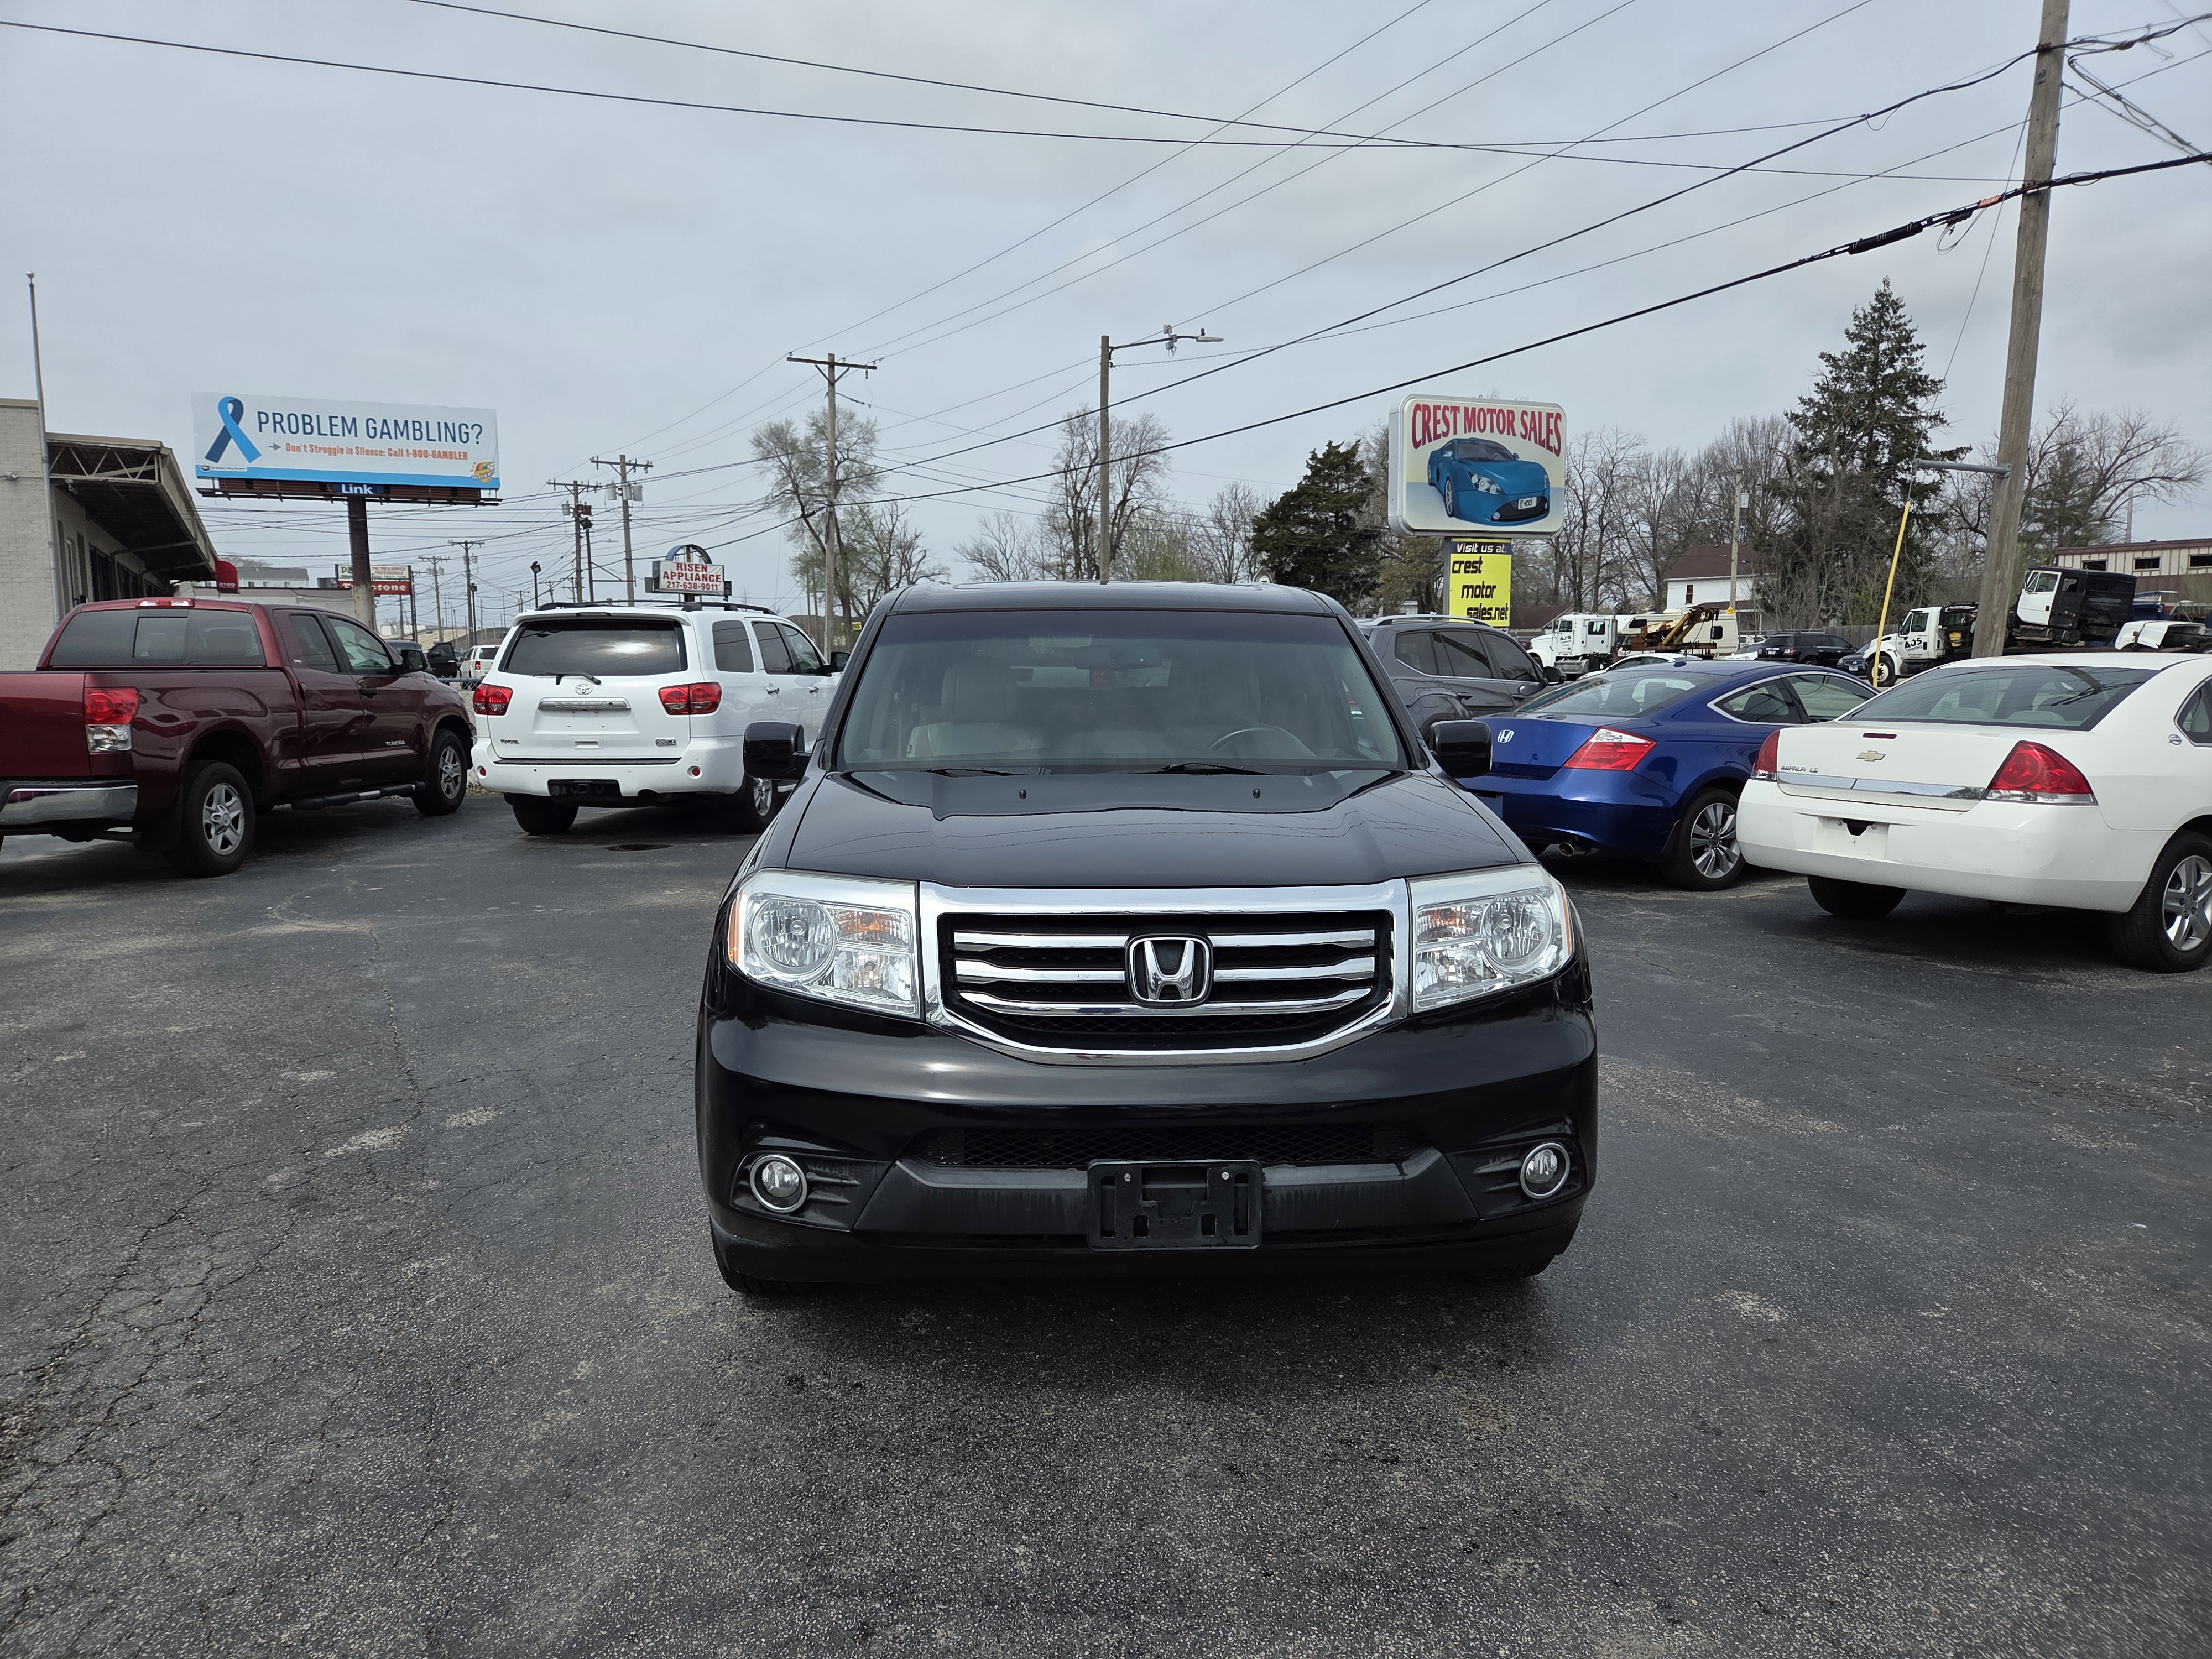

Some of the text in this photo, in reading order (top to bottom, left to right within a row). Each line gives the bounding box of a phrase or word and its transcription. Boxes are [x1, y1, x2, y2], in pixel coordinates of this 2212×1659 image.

[257, 411, 483, 445] PROBLEM GAMBLING?
[1412, 404, 1562, 458] CREST MOTOR SALES
[285, 443, 307, 452] Don't
[309, 444, 344, 456] Struggle
[355, 446, 386, 456] Silence:
[388, 448, 403, 457] Call
[405, 448, 468, 460] 1-800-GAMBLER
[341, 484, 375, 494] Link
[1457, 542, 1478, 553] Visit
[676, 562, 708, 572] RISEN
[1452, 556, 1483, 574] crest
[663, 571, 722, 582] APPLIANCE
[666, 581, 718, 591] 217-638-9011
[1461, 581, 1496, 599] motor
[1467, 603, 1509, 620] sales.net
